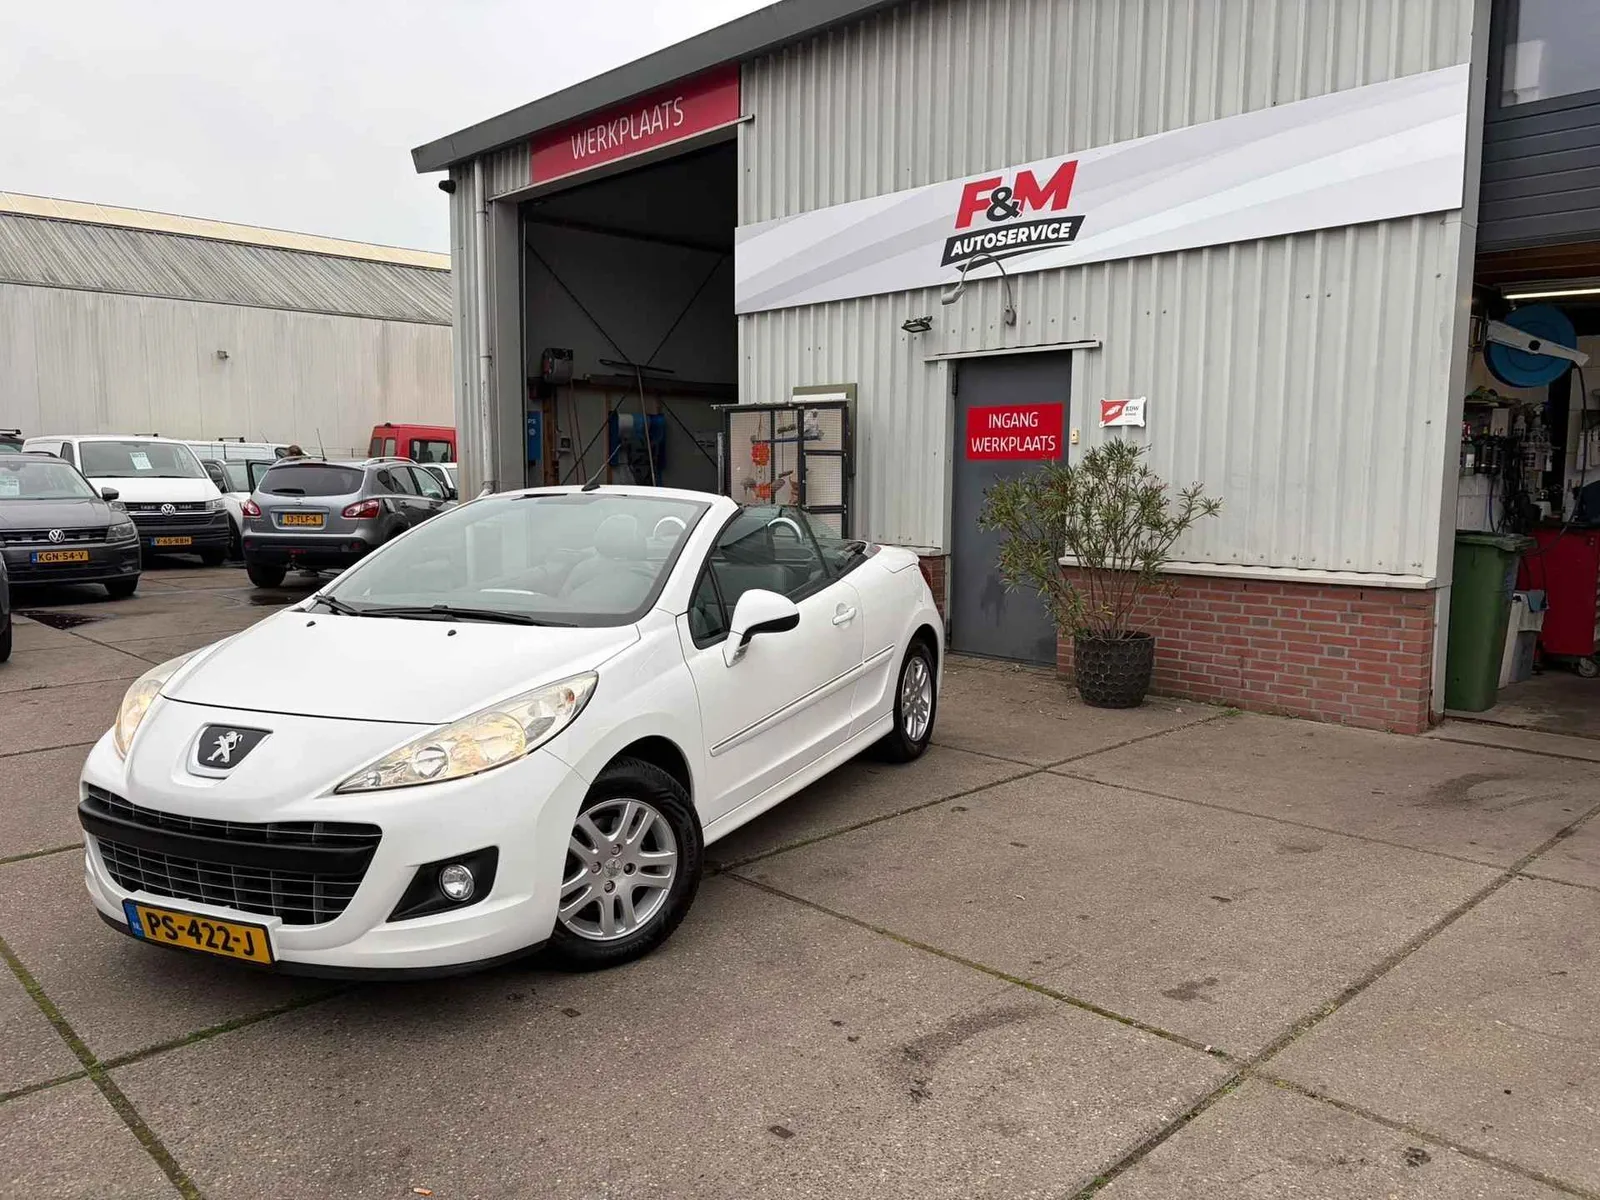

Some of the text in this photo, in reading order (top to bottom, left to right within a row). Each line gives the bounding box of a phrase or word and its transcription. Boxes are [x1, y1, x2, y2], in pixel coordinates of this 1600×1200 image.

[571, 96, 684, 160] WERKPLAATS
[955, 160, 1078, 229] F&M
[950, 222, 1072, 257] AUTOSERVICE
[988, 411, 1039, 429] INGANG
[971, 435, 1056, 453] WERKPLAATS
[145, 911, 255, 956] PS-422-J
